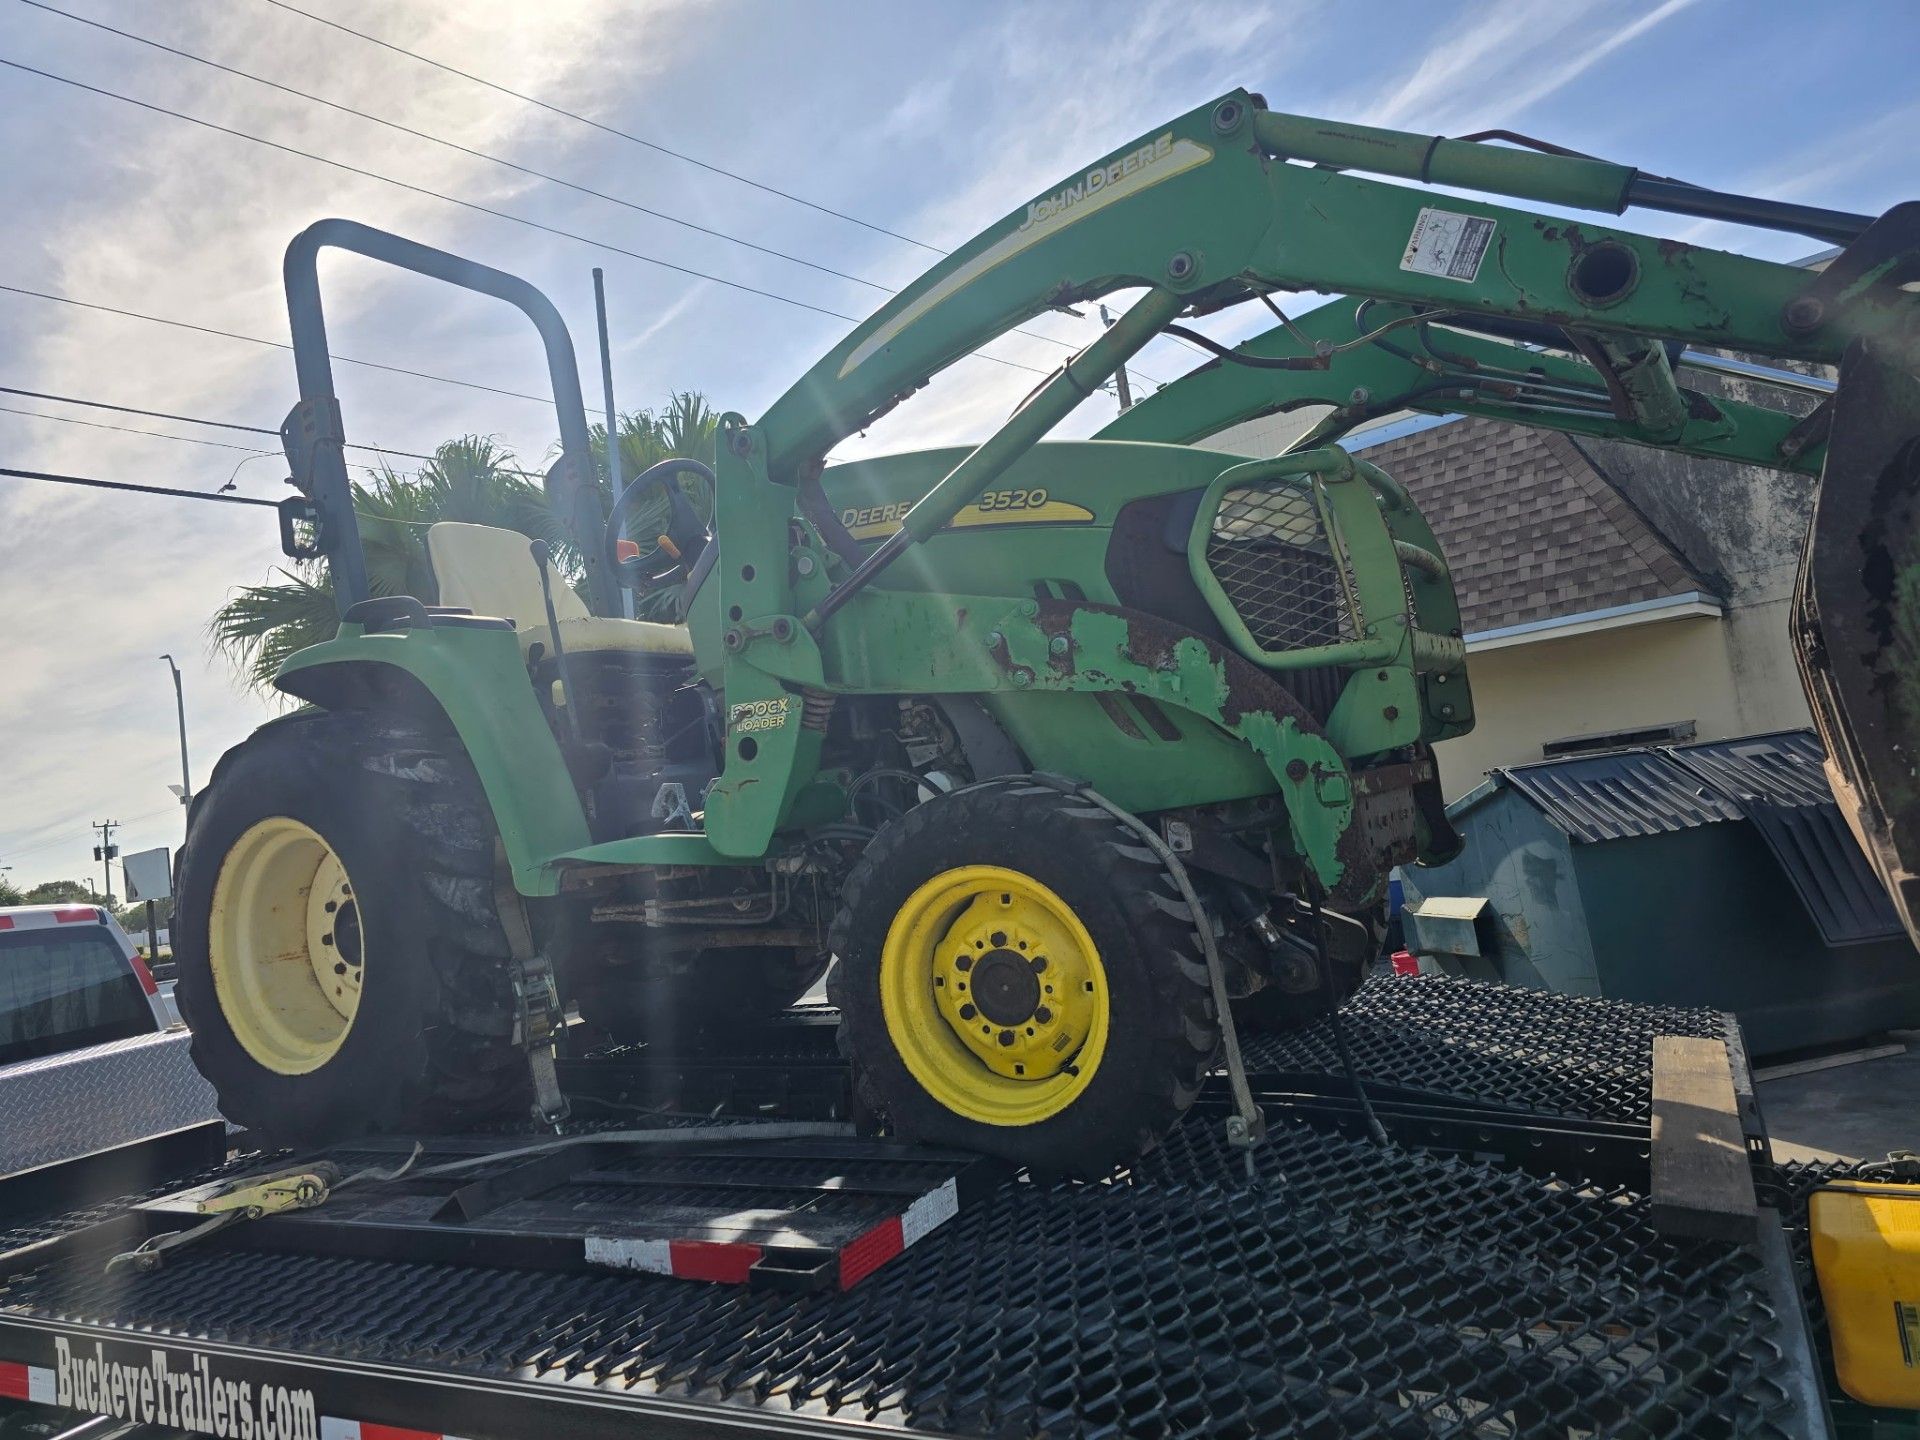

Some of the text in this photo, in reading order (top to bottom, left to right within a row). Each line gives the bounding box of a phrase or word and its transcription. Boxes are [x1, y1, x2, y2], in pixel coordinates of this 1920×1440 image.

[1019, 131, 1173, 231] JOHN DEERE
[841, 488, 1048, 529] DEERE 3520
[737, 716, 785, 733] LOADER
[54, 1336, 318, 1440] BuckeyeTrailers.com
